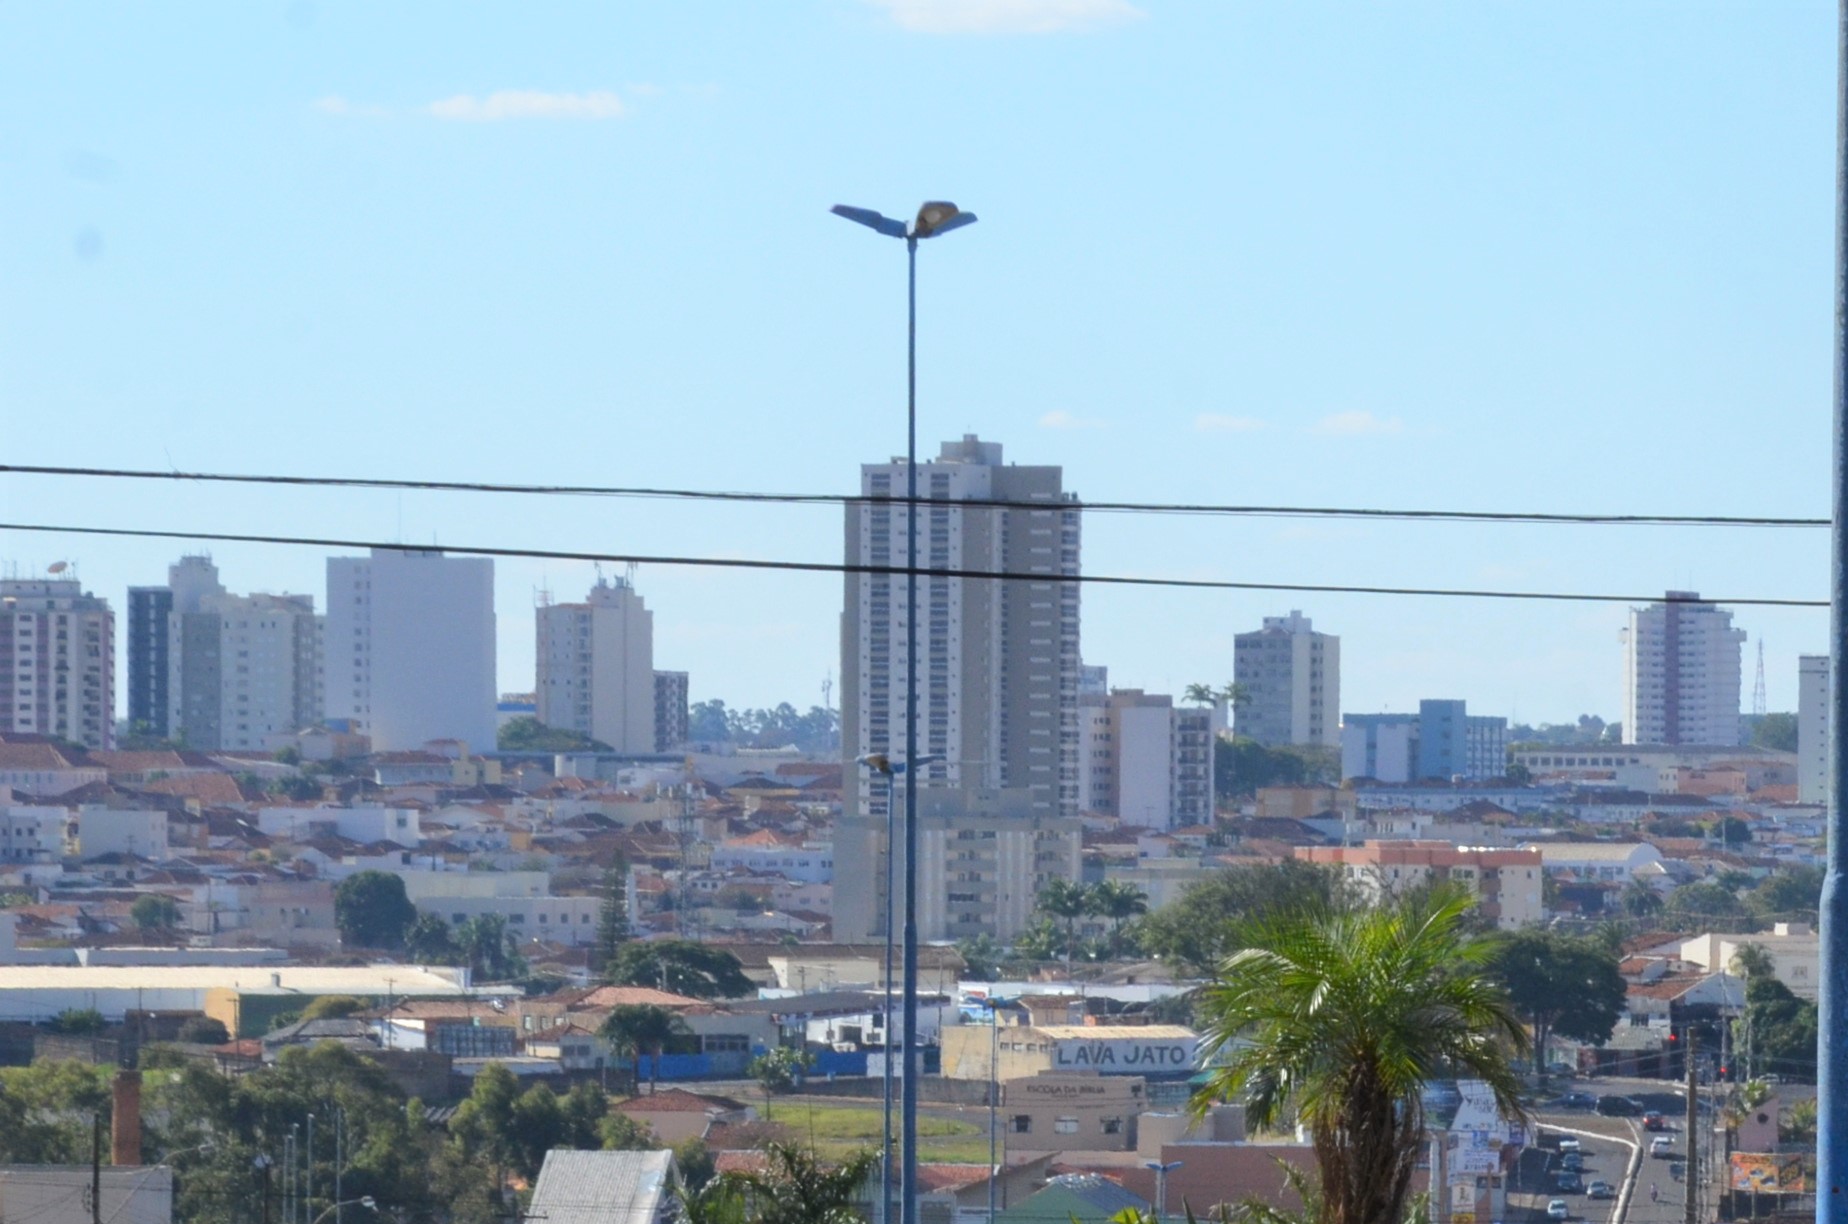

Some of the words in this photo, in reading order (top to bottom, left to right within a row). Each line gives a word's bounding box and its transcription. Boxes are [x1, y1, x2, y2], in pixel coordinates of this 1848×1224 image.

[1057, 1045, 1115, 1065] LAVA
[1124, 1045, 1186, 1065] JATO
[1026, 1085, 1063, 1095] ESCOLA
[1064, 1086, 1078, 1095] DA
